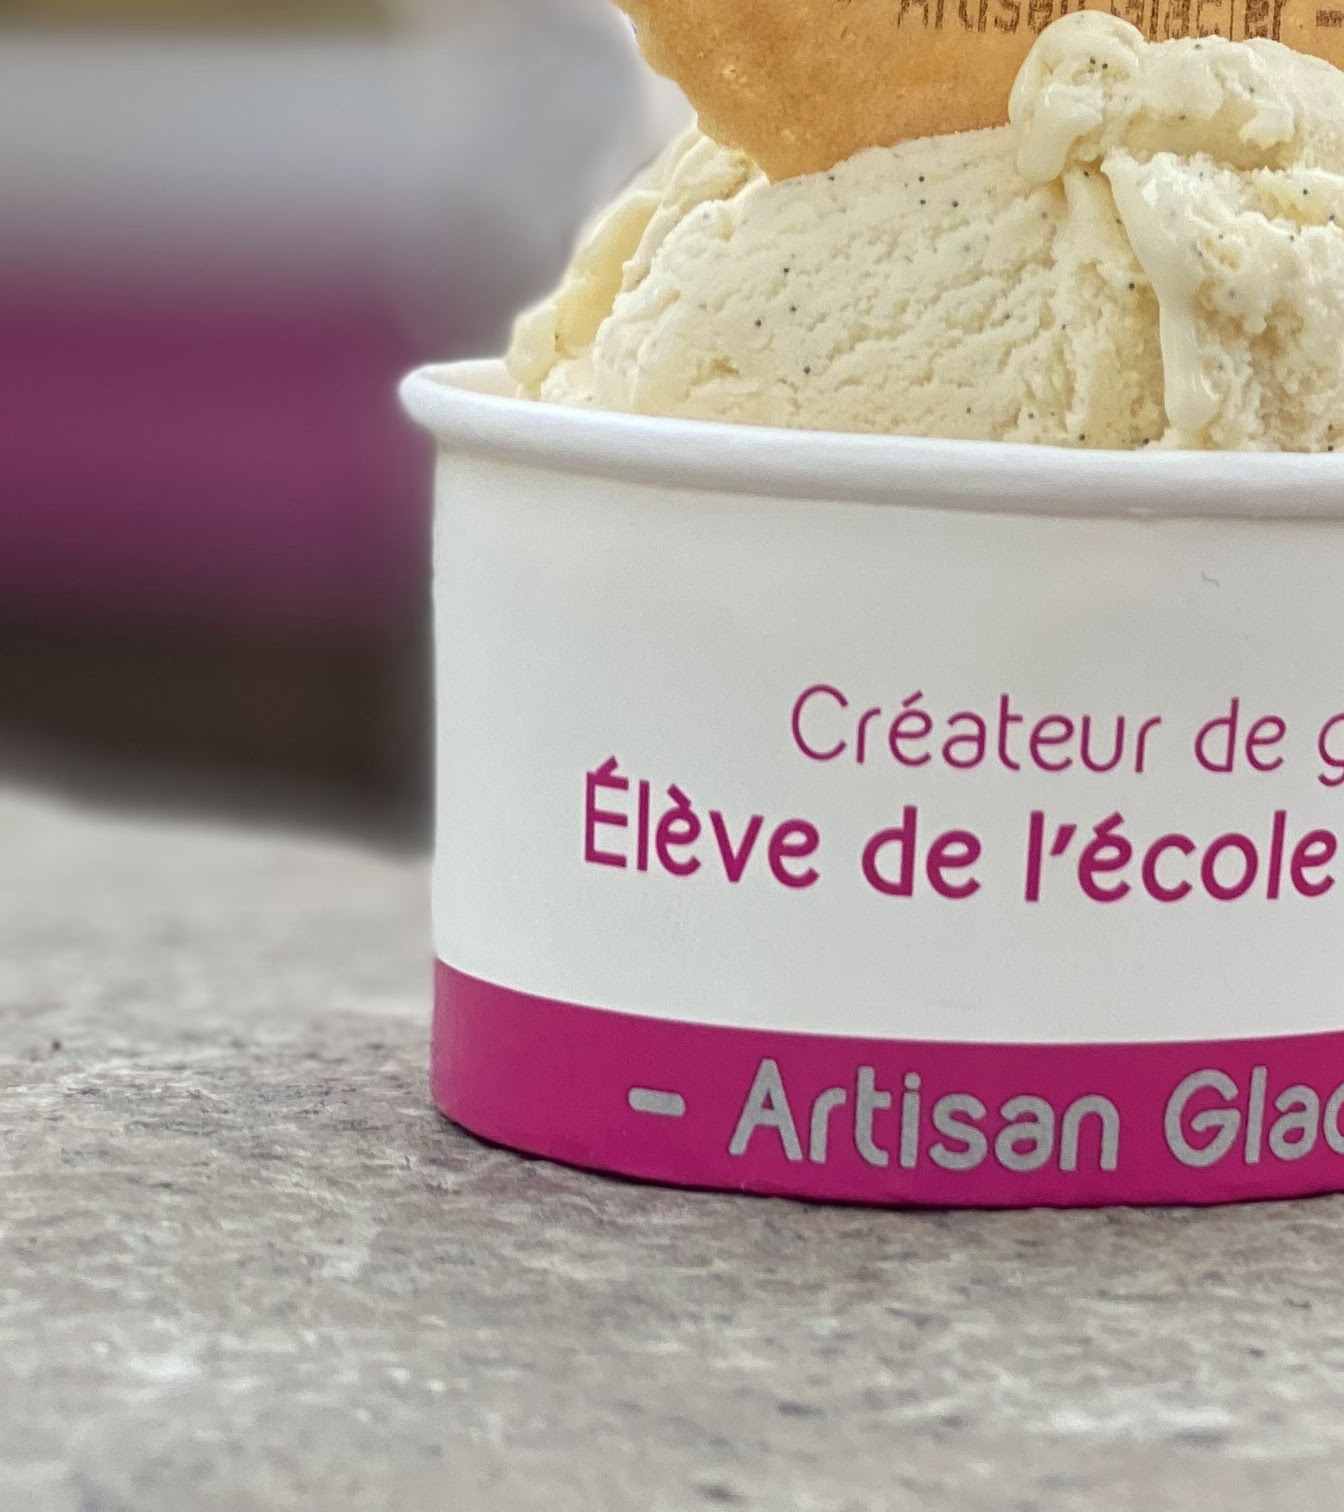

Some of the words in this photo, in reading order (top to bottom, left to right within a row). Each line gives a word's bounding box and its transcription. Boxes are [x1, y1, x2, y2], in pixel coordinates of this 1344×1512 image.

[790, 683, 1160, 774] Créateur
[1194, 698, 1286, 772] de
[584, 757, 820, 888] Élève
[861, 806, 983, 898] de
[1024, 811, 1338, 903] l'école
[727, 1058, 1118, 1172] Artisan
